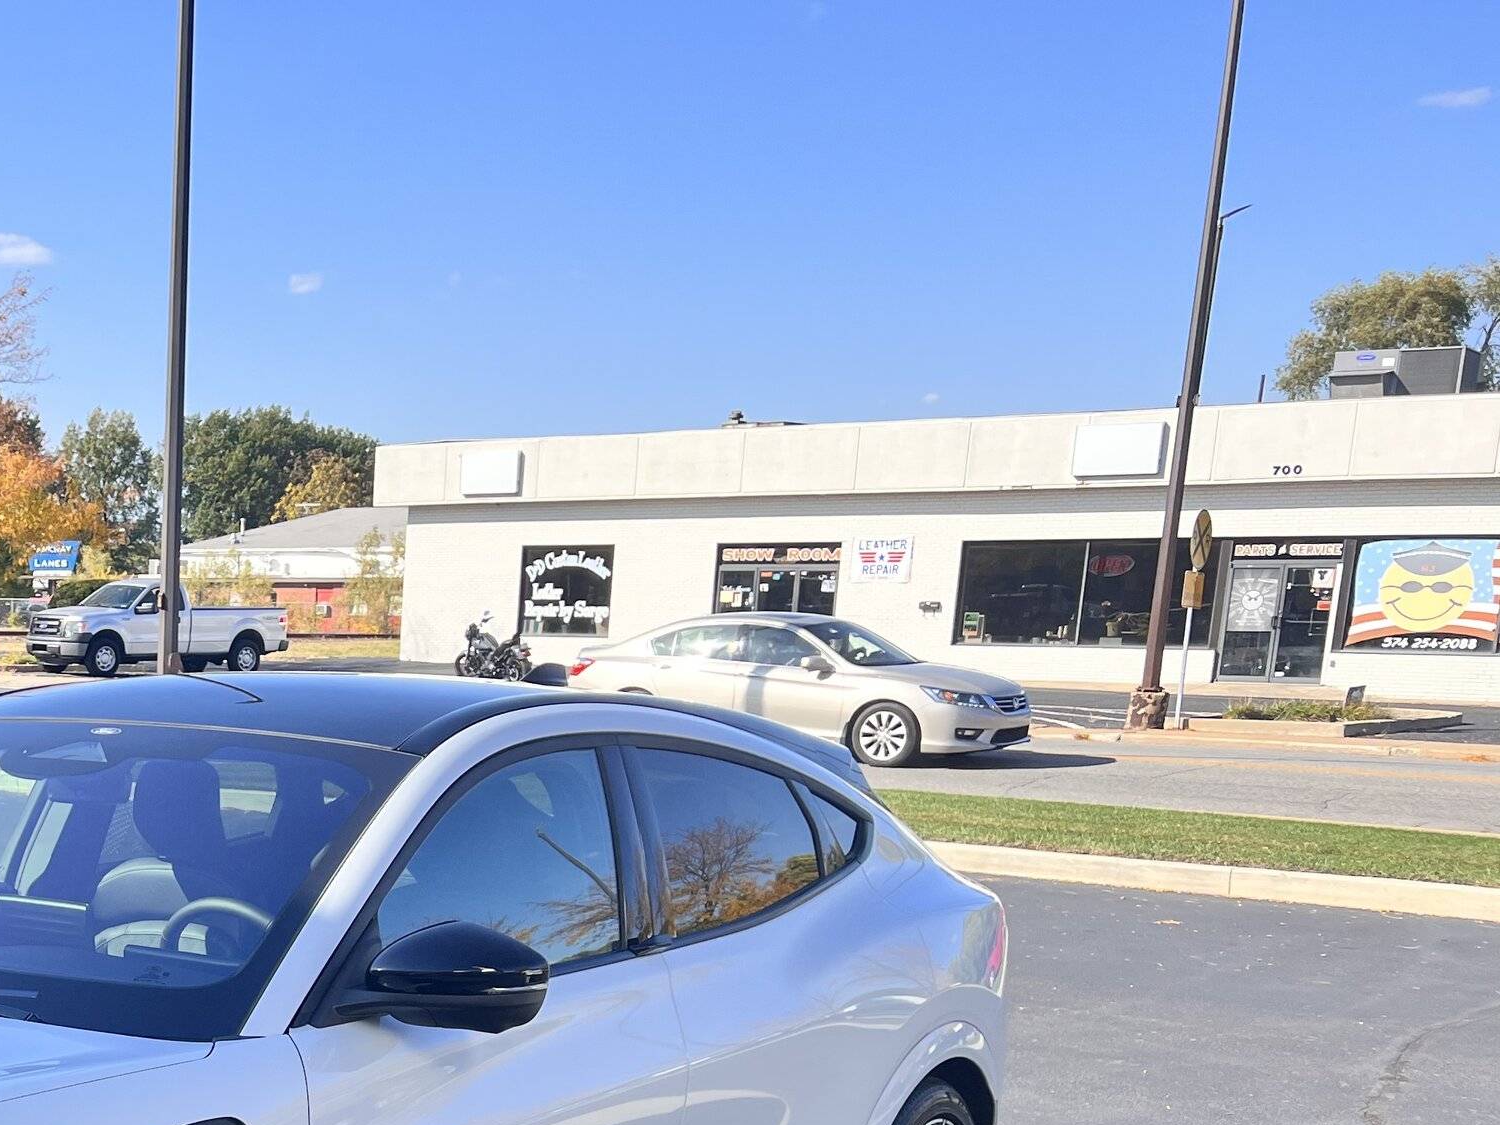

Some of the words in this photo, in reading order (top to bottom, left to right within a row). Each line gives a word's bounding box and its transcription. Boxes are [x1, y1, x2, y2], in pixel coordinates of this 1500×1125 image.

[1272, 464, 1303, 476] 700
[858, 539, 908, 550] LEATHER
[1234, 544, 1276, 557] PARTS
[1289, 543, 1344, 556] SERVICE
[722, 548, 775, 562] SHOW
[786, 547, 842, 562] ROOM
[34, 559, 68, 568] LANES
[861, 564, 900, 575] REPAIR
[558, 600, 574, 623] by
[1381, 636, 1409, 649] 574
[1411, 637, 1478, 650] 254-2088
